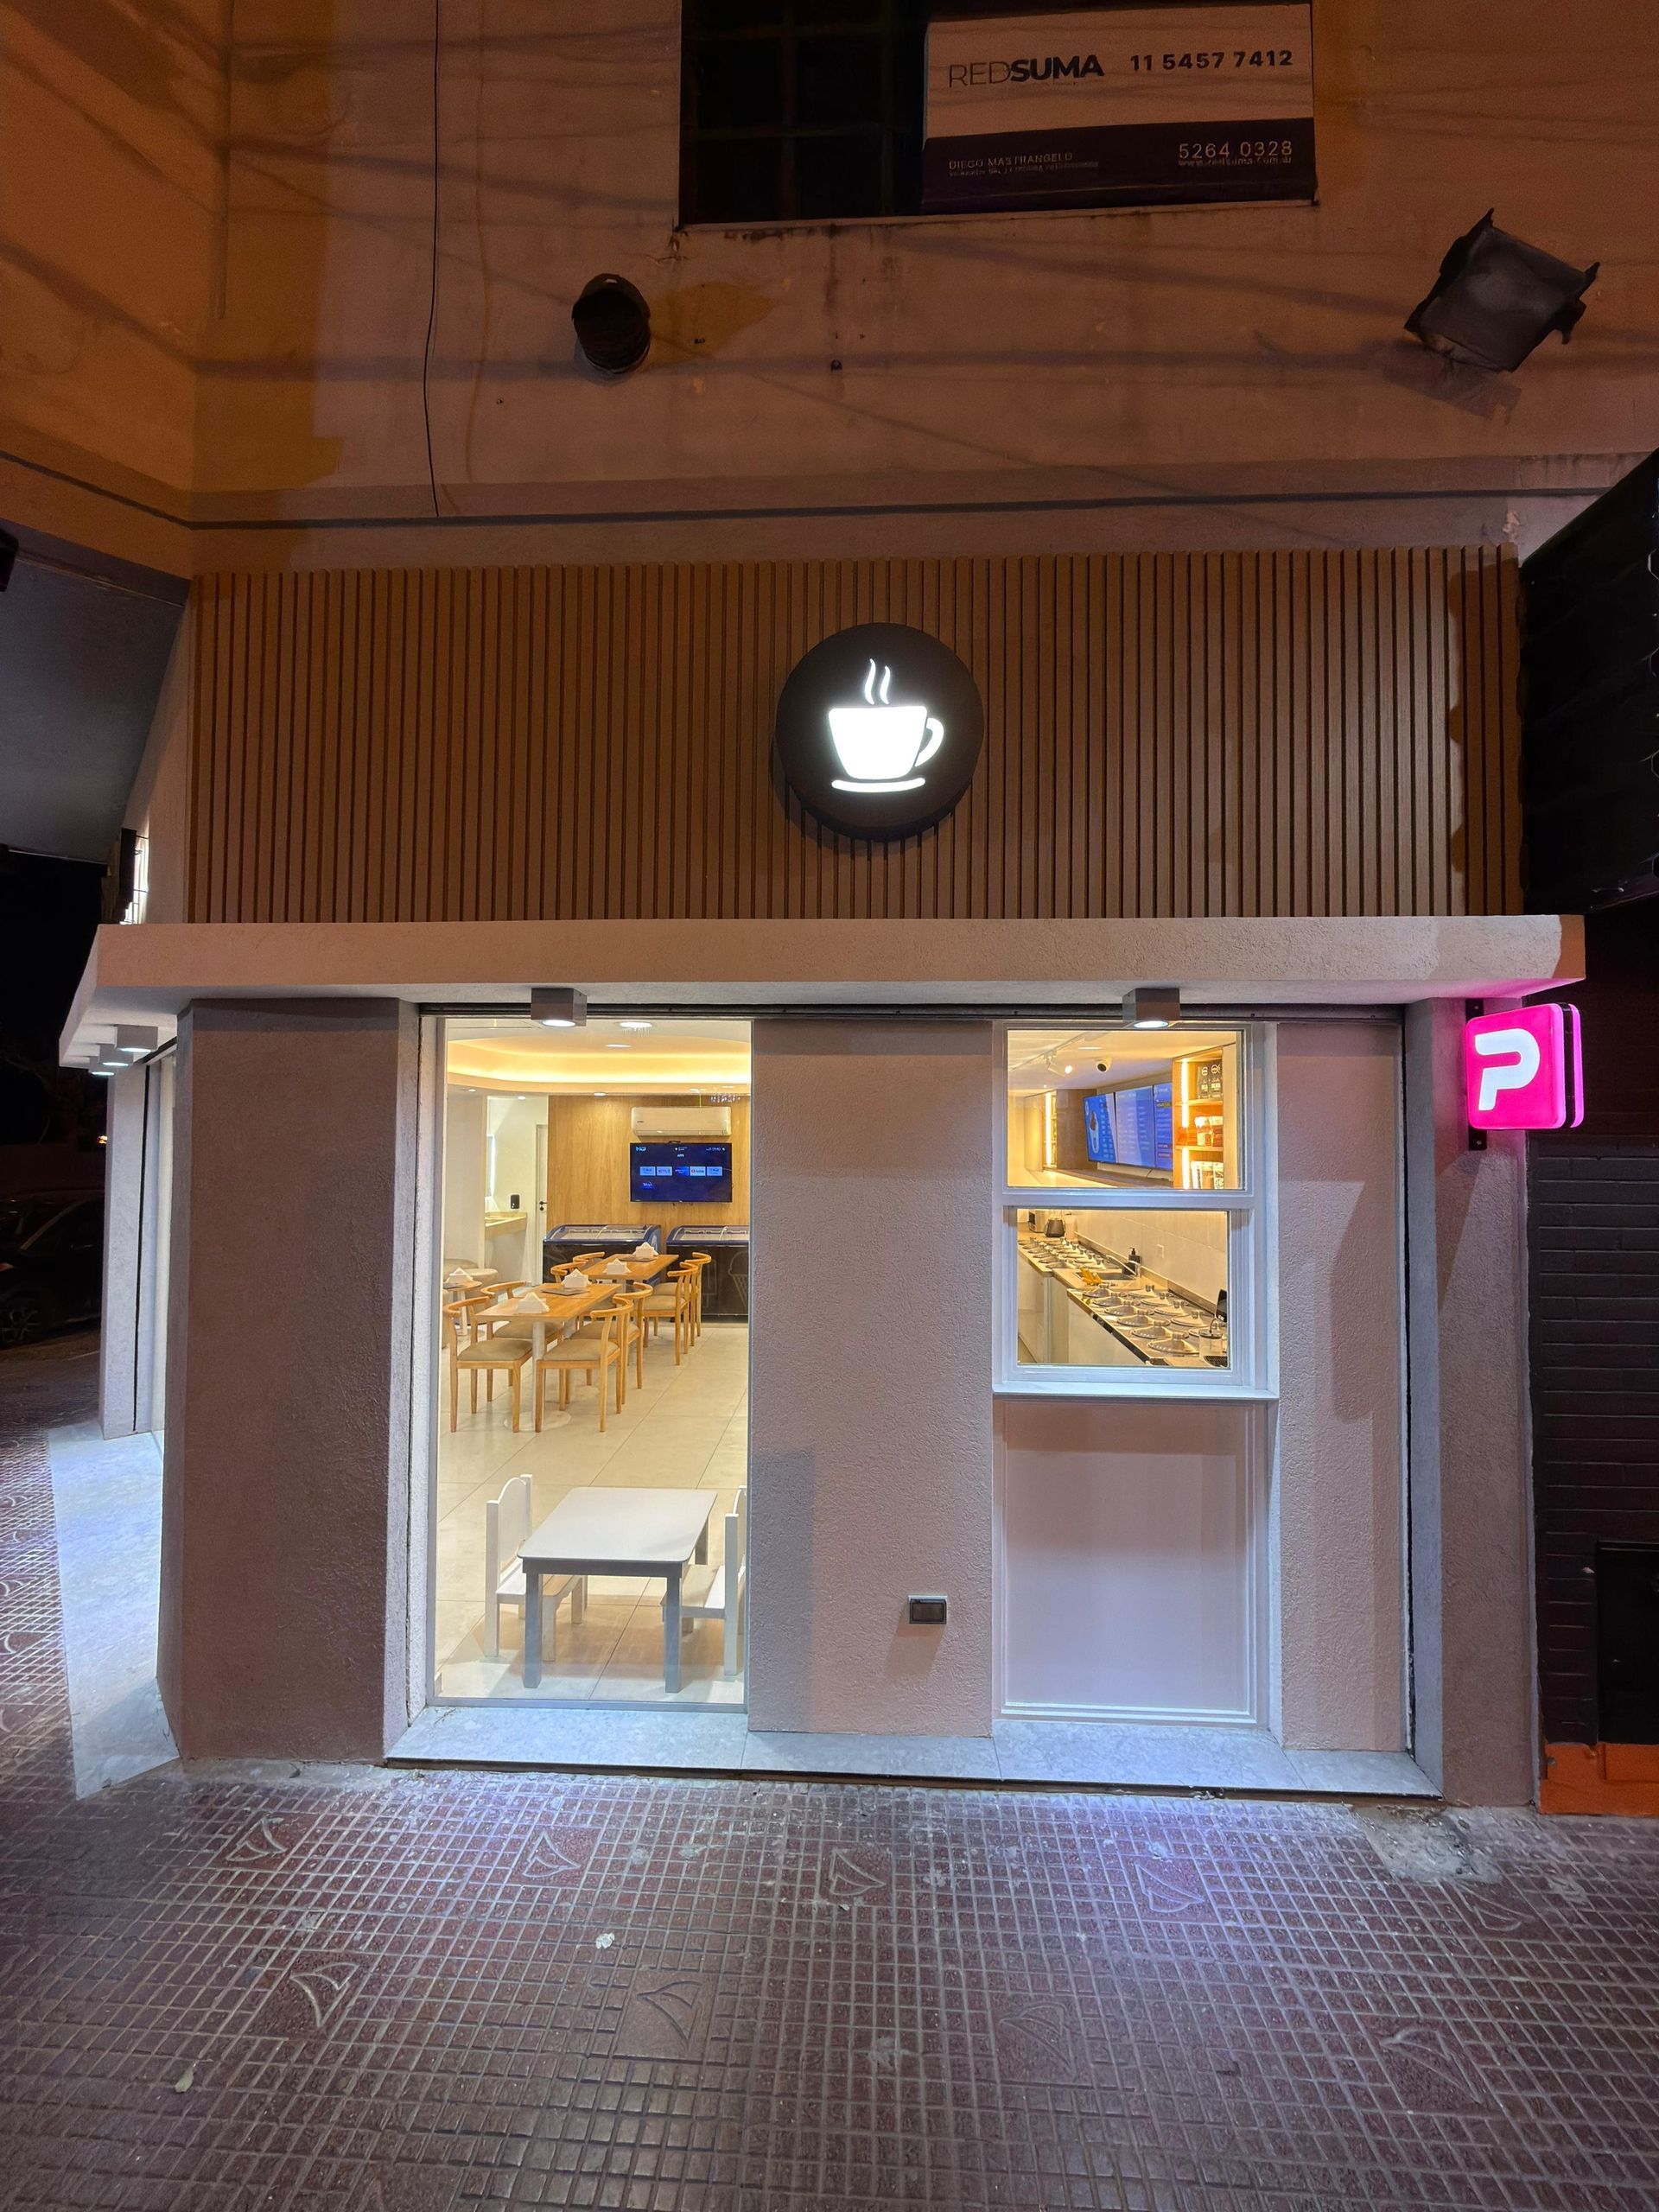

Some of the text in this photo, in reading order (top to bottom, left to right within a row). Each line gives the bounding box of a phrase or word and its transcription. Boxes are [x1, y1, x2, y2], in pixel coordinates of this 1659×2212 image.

[949, 54, 1104, 87] REDSUMA
[1130, 50, 1293, 71] 11 5457 7412
[1179, 140, 1293, 159] 5264 0328
[948, 158, 984, 170] DIEGO
[1475, 1028, 1540, 1110] P
